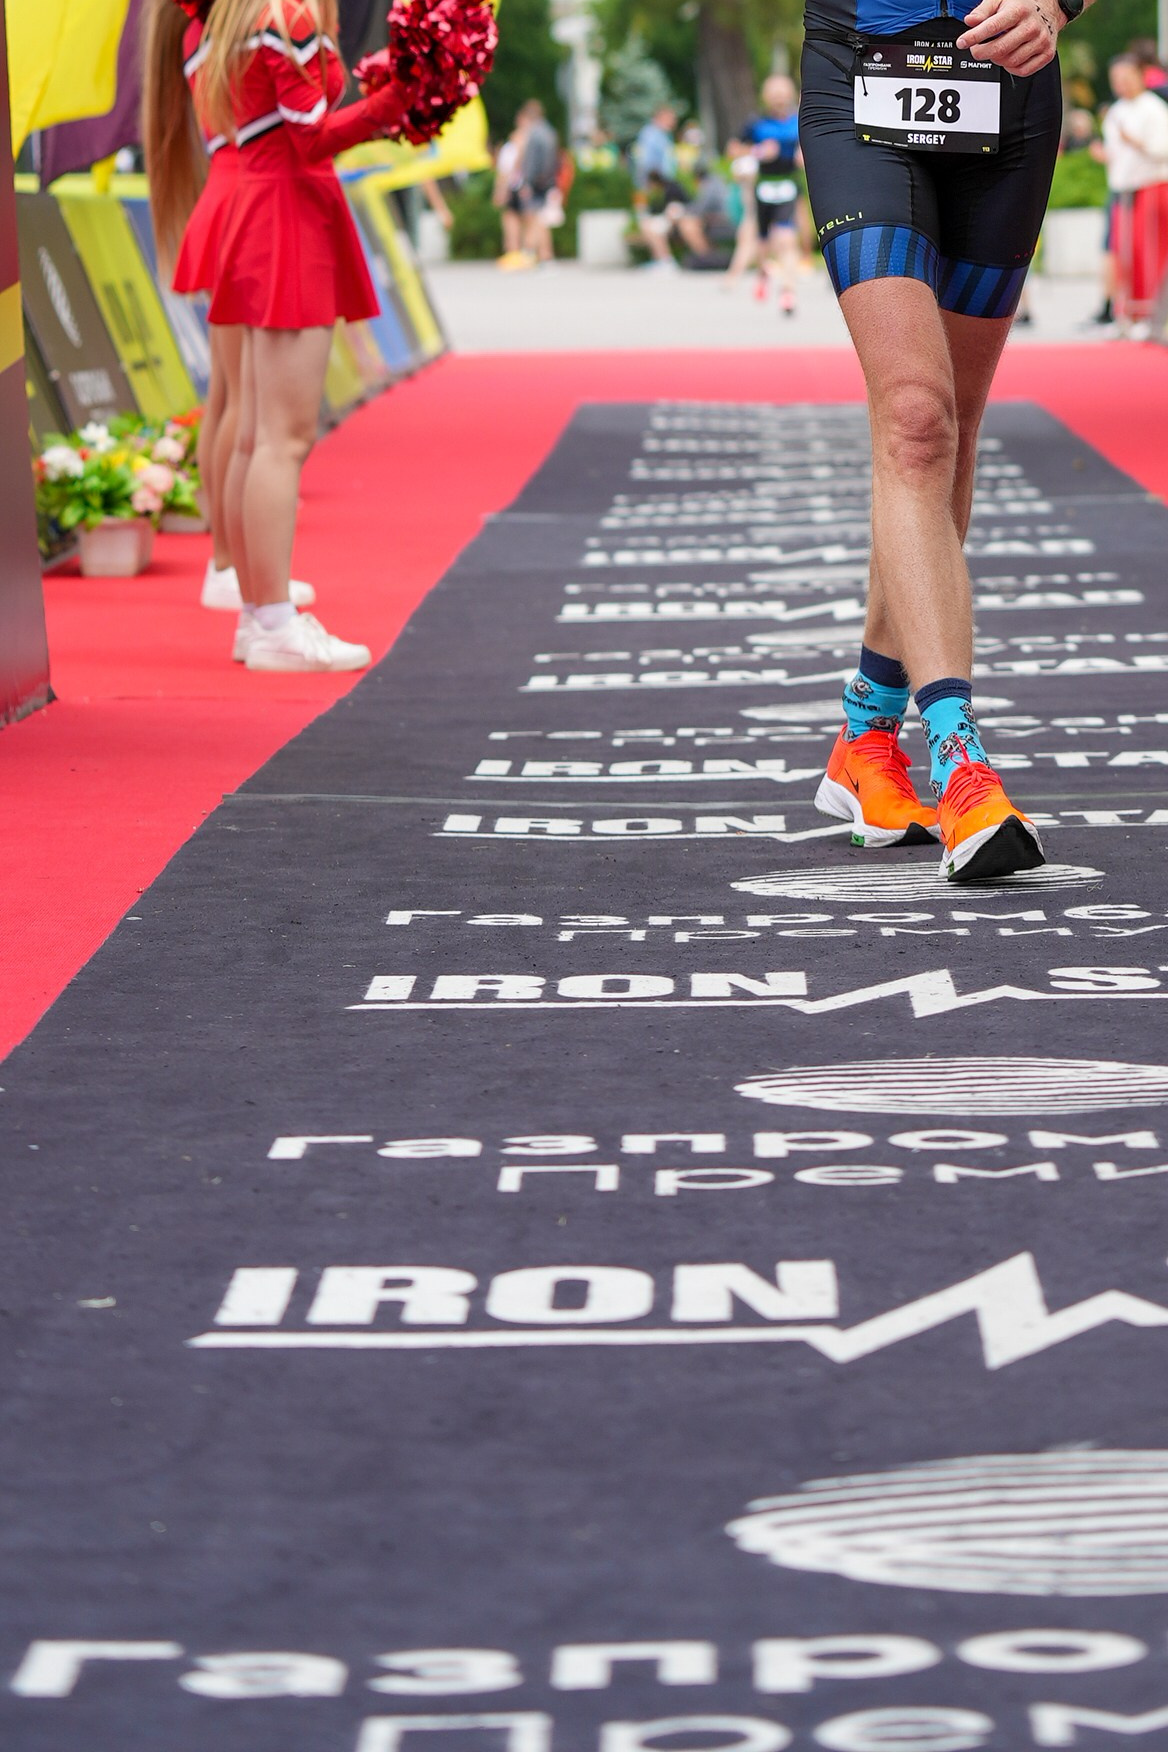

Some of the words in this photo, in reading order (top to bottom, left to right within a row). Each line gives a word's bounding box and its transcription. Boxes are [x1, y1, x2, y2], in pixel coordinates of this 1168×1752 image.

[914, 40, 930, 48] IRON
[906, 54, 926, 65] IRON
[933, 55, 953, 66] STAR
[967, 61, 993, 69] МАГНИТ
[894, 87, 961, 124] 128
[907, 133, 947, 145] SERGEY
[474, 758, 786, 777] IRON
[441, 813, 787, 834] IRON
[363, 970, 808, 1001] IRON
[213, 1258, 840, 1327] IRON
